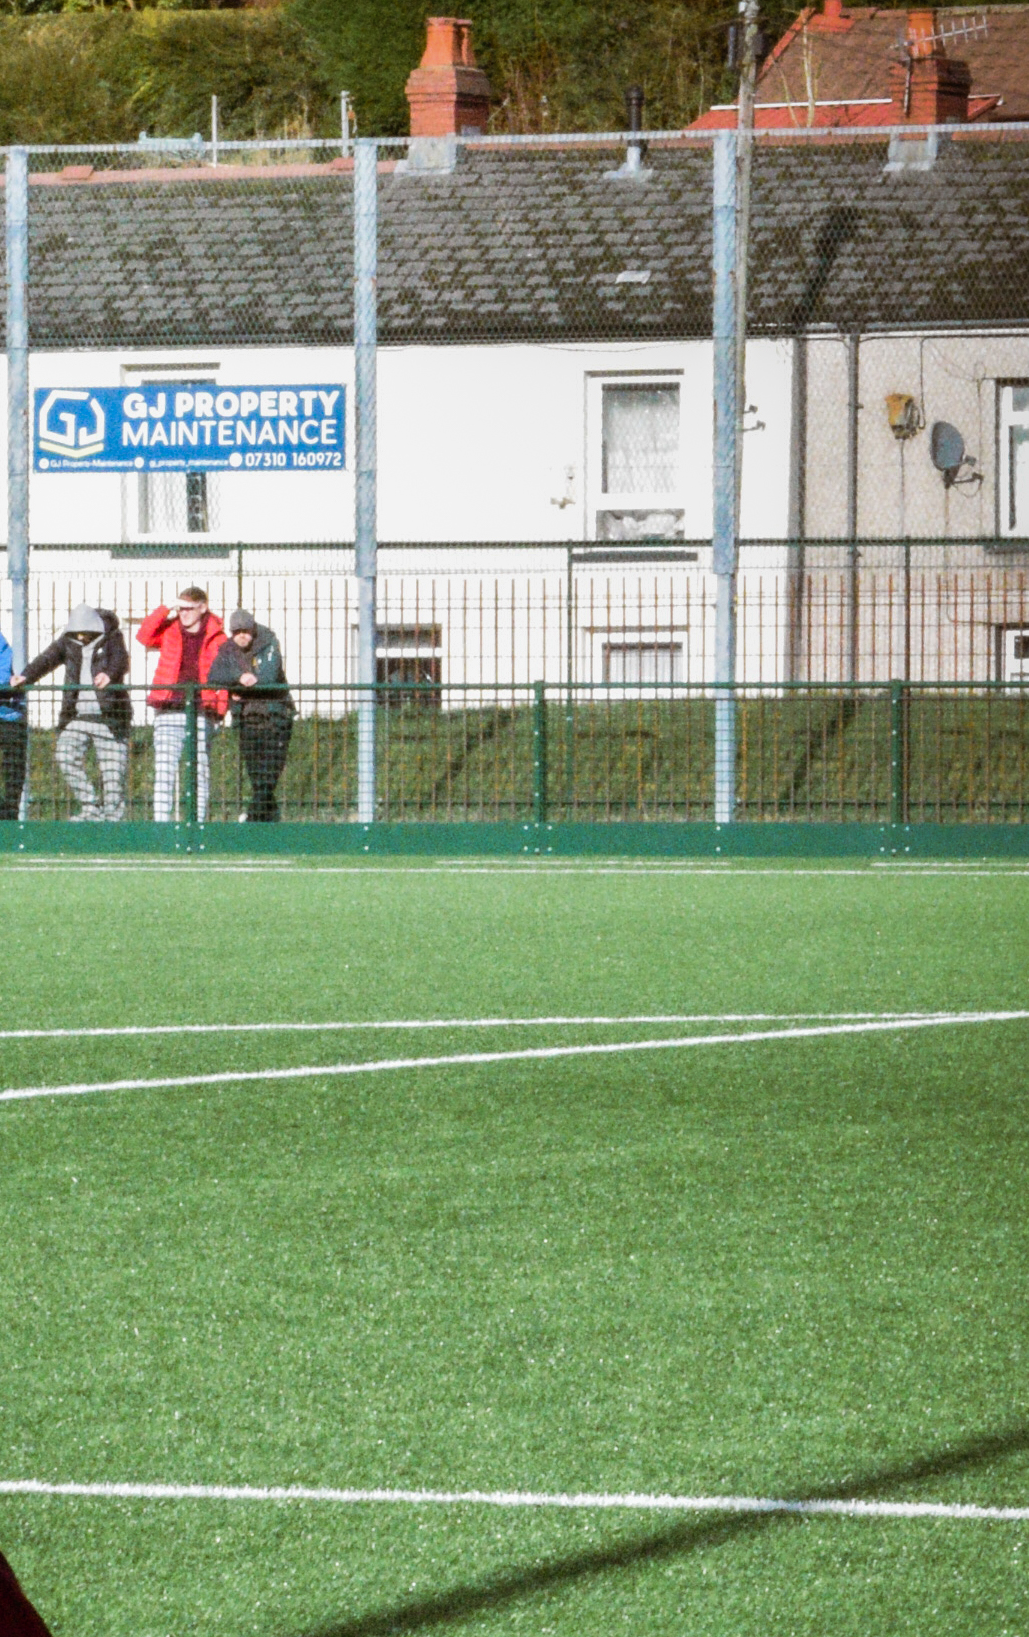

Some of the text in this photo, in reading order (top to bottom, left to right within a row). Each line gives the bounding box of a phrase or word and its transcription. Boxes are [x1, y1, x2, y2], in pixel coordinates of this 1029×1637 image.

[123, 390, 340, 418] GJ PROPERTY
[122, 419, 337, 446] MAINTENANCE
[50, 459, 61, 468] GJ
[245, 452, 342, 467] 07310 160972
